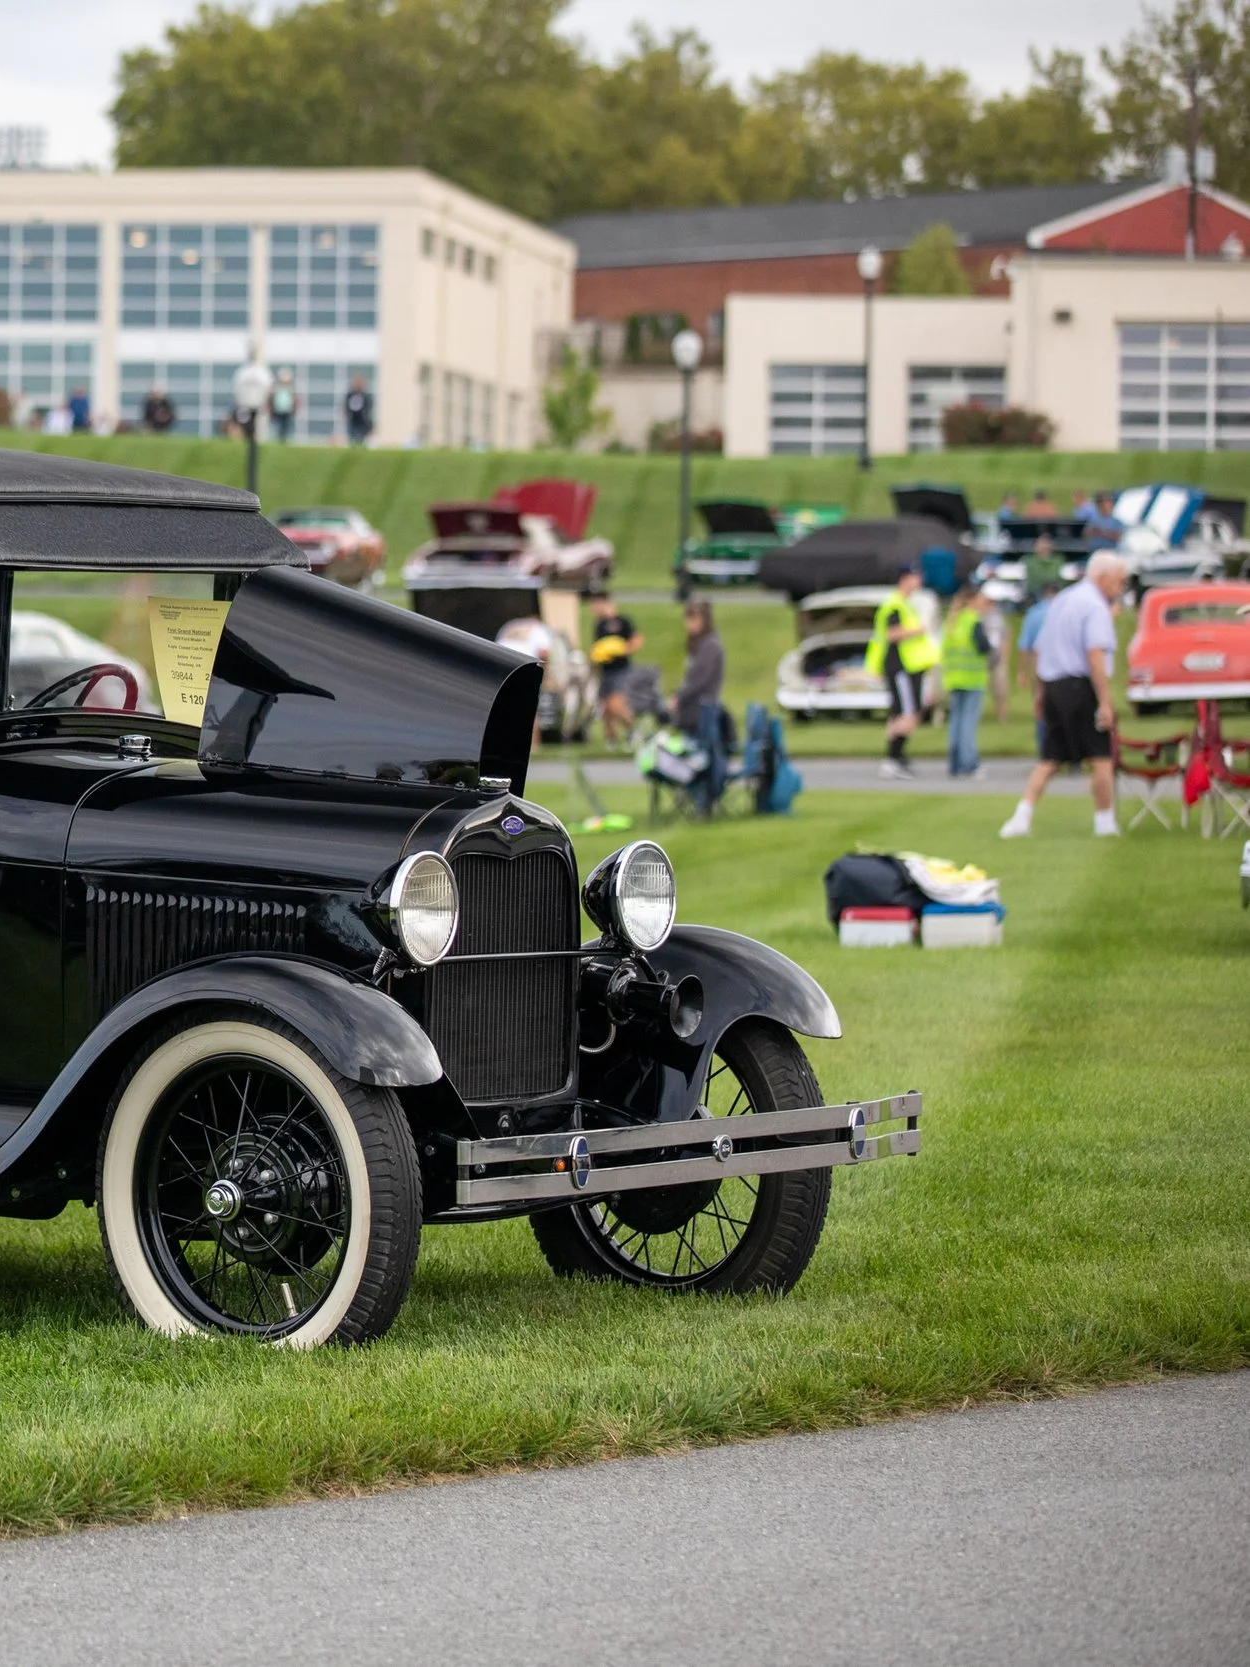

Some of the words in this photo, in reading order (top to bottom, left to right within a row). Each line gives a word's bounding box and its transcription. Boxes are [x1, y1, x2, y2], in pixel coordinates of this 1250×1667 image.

[171, 670, 193, 681] 39844
[181, 692, 187, 703] E
[189, 694, 204, 706] 120
